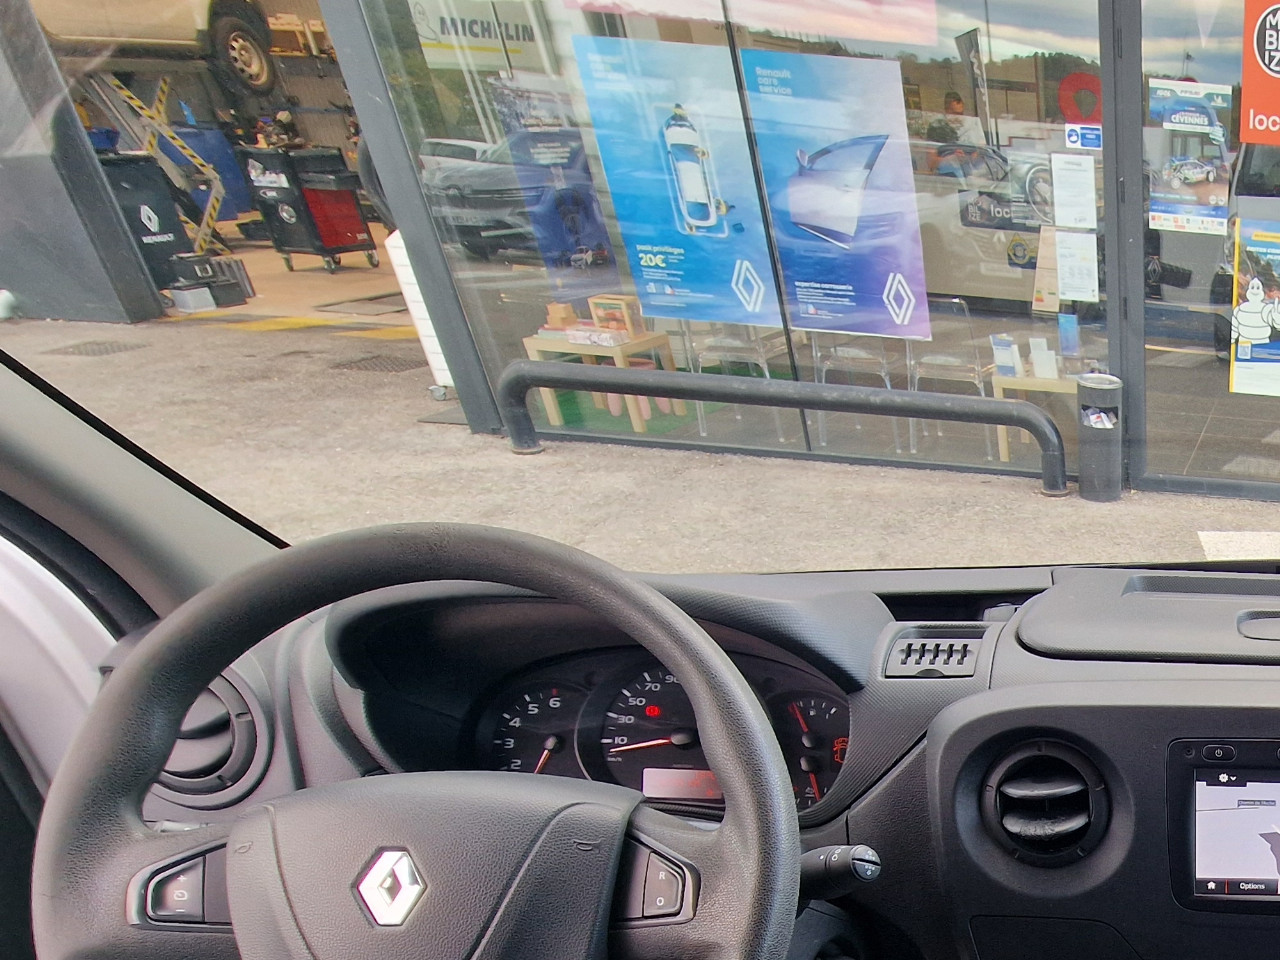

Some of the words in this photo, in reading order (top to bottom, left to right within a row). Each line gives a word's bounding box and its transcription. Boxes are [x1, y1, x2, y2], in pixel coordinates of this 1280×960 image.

[638, 253, 667, 268] 20€
[644, 683, 661, 691] 70
[549, 697, 561, 708] 6
[628, 697, 646, 706] 50
[527, 704, 539, 714] 5
[509, 717, 521, 728] 4
[617, 715, 635, 724] 30
[504, 738, 515, 749] 3
[614, 736, 628, 745] 10
[510, 760, 522, 770] 2
[659, 871, 666, 880] R
[1239, 882, 1266, 891] Options
